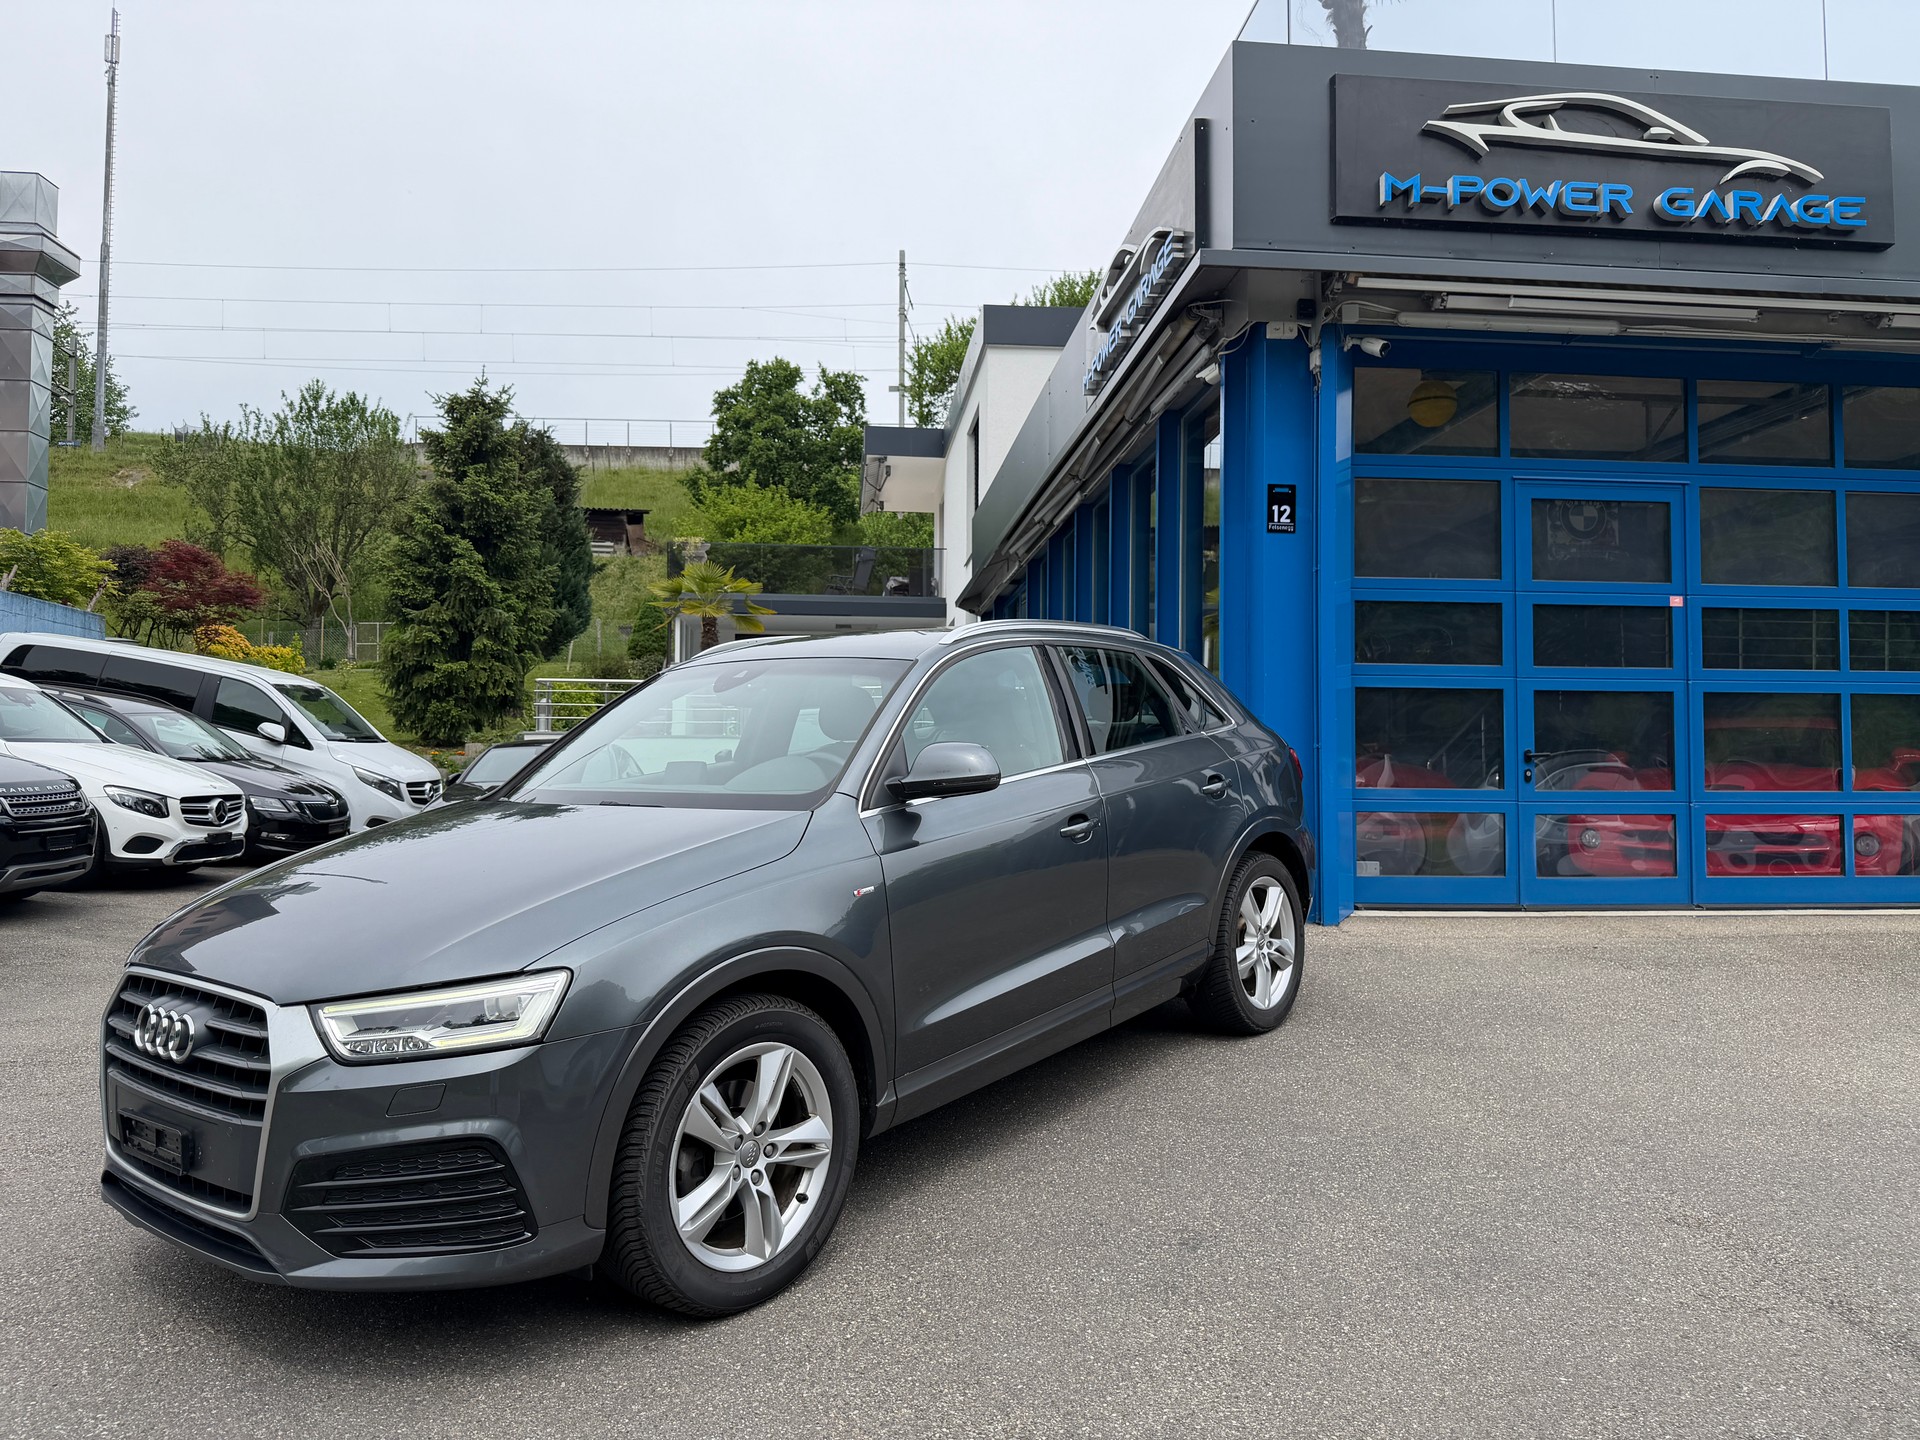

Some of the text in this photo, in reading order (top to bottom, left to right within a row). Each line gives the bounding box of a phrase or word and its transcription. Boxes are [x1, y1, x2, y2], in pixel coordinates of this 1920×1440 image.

[1382, 172, 1867, 227] M-POWER GARAGE
[1082, 231, 1174, 396] M-POWER GARAGE
[1272, 505, 1291, 523] 12
[46, 783, 76, 791] ROVER
